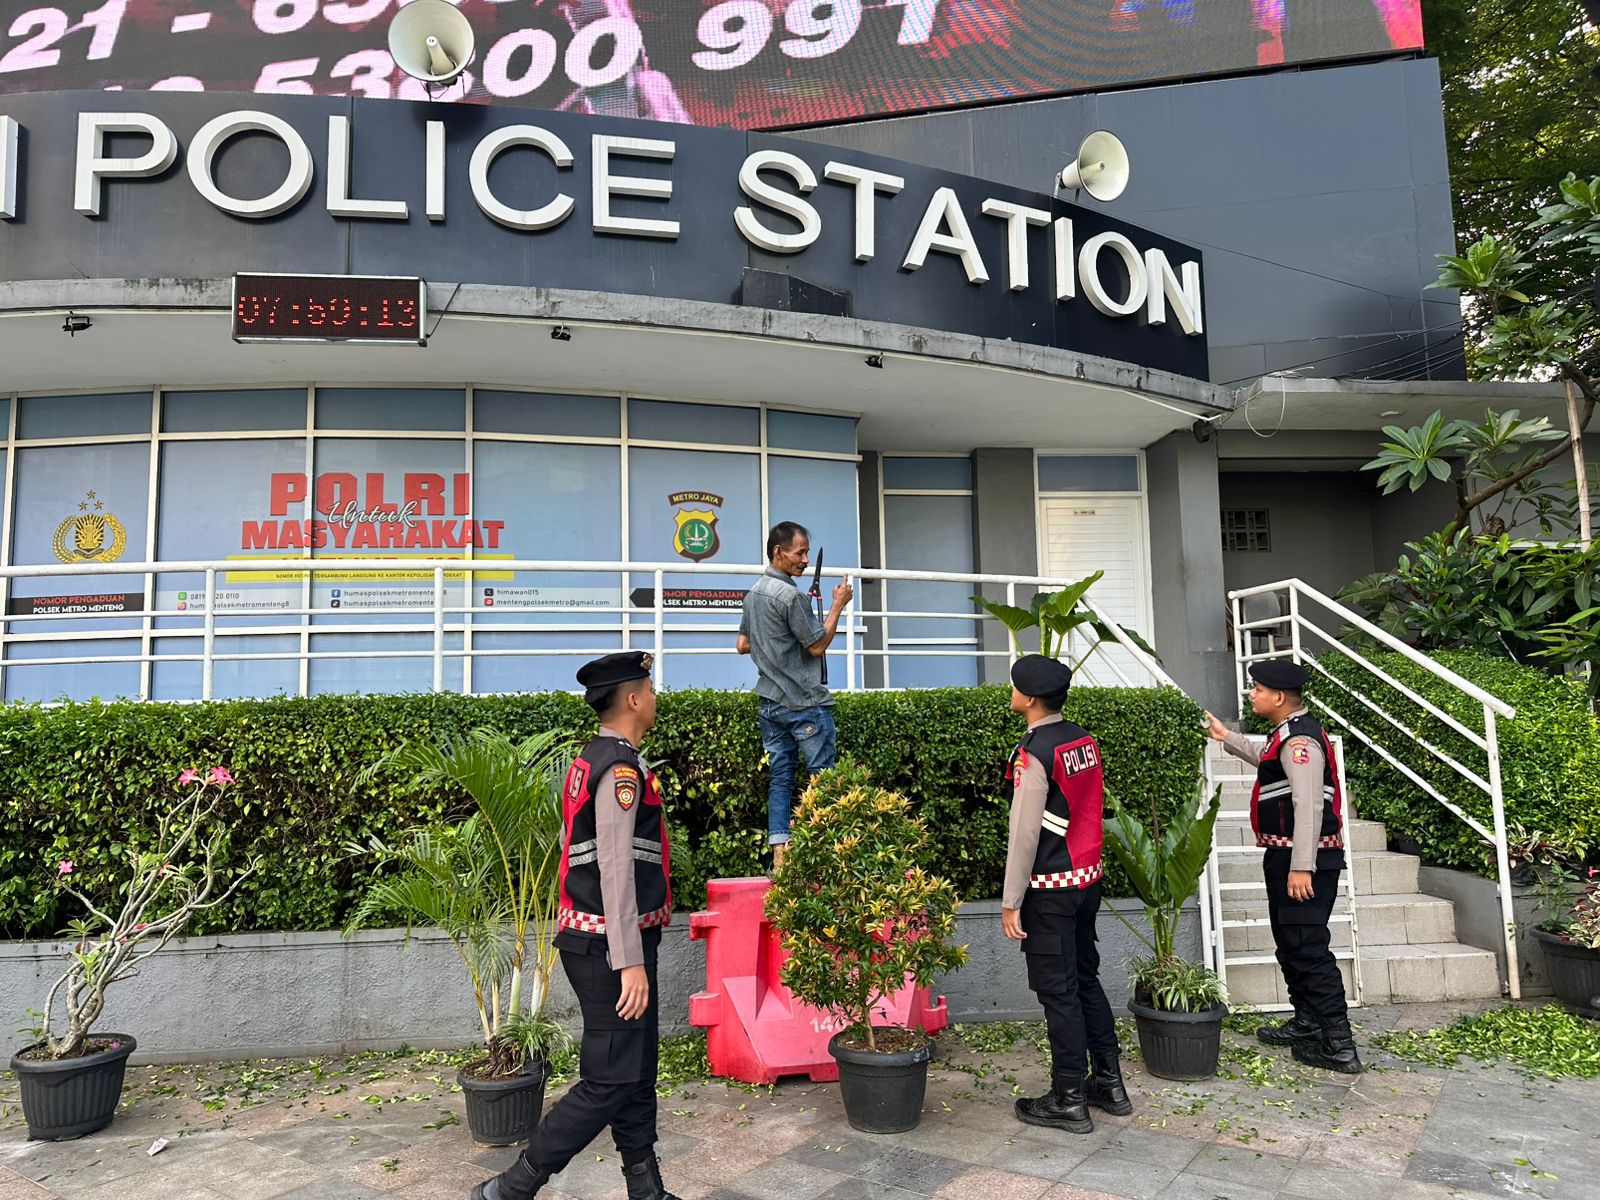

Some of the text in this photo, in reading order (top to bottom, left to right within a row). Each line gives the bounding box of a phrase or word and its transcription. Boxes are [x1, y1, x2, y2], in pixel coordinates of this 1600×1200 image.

[74, 109, 680, 239] POLICE
[734, 149, 1204, 337] STATION
[270, 472, 470, 516] POLRI
[673, 493, 719, 504] METRO JAYA
[327, 499, 419, 529] Untuk
[241, 519, 505, 549] MASYARAKAT
[33, 594, 125, 606] NOMOR PENGADUAN
[33, 603, 124, 614] POLSEK METRO MENTENG
[660, 590, 743, 599] OMOR PENGADUAN
[1063, 743, 1098, 775] POLISI
